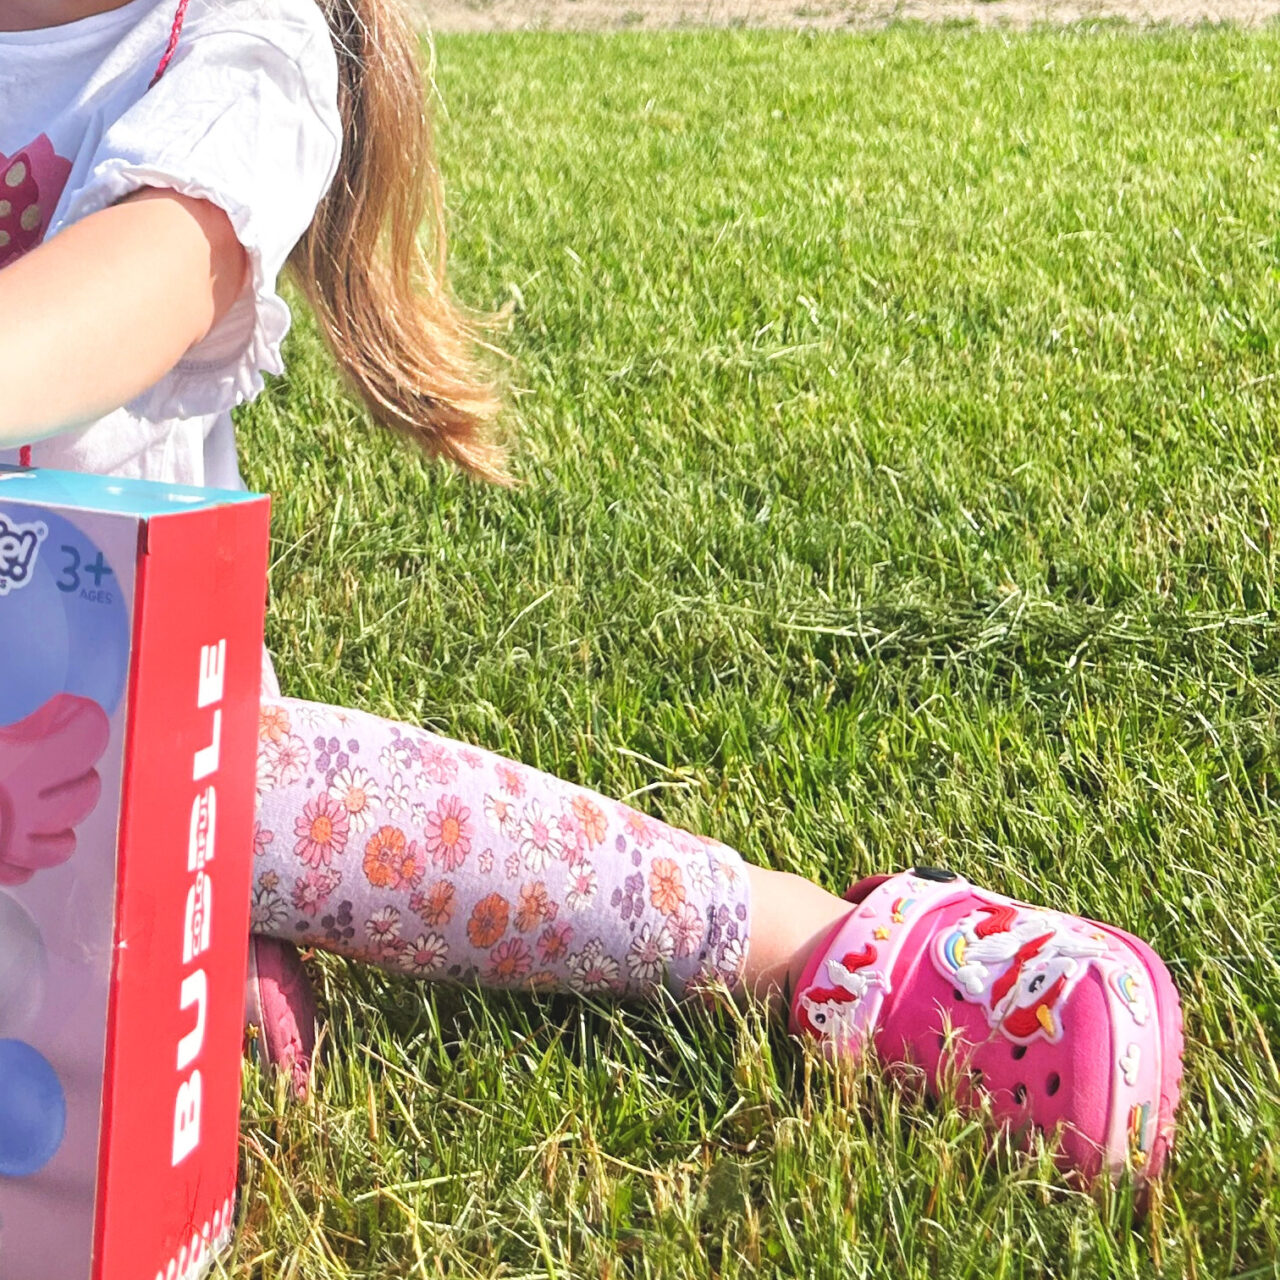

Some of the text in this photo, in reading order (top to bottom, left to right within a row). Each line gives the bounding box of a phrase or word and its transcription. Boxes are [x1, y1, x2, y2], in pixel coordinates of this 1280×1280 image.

[56, 545, 113, 592] 3+
[80, 589, 113, 604] AGES
[192, 787, 210, 958] COLORFUL
